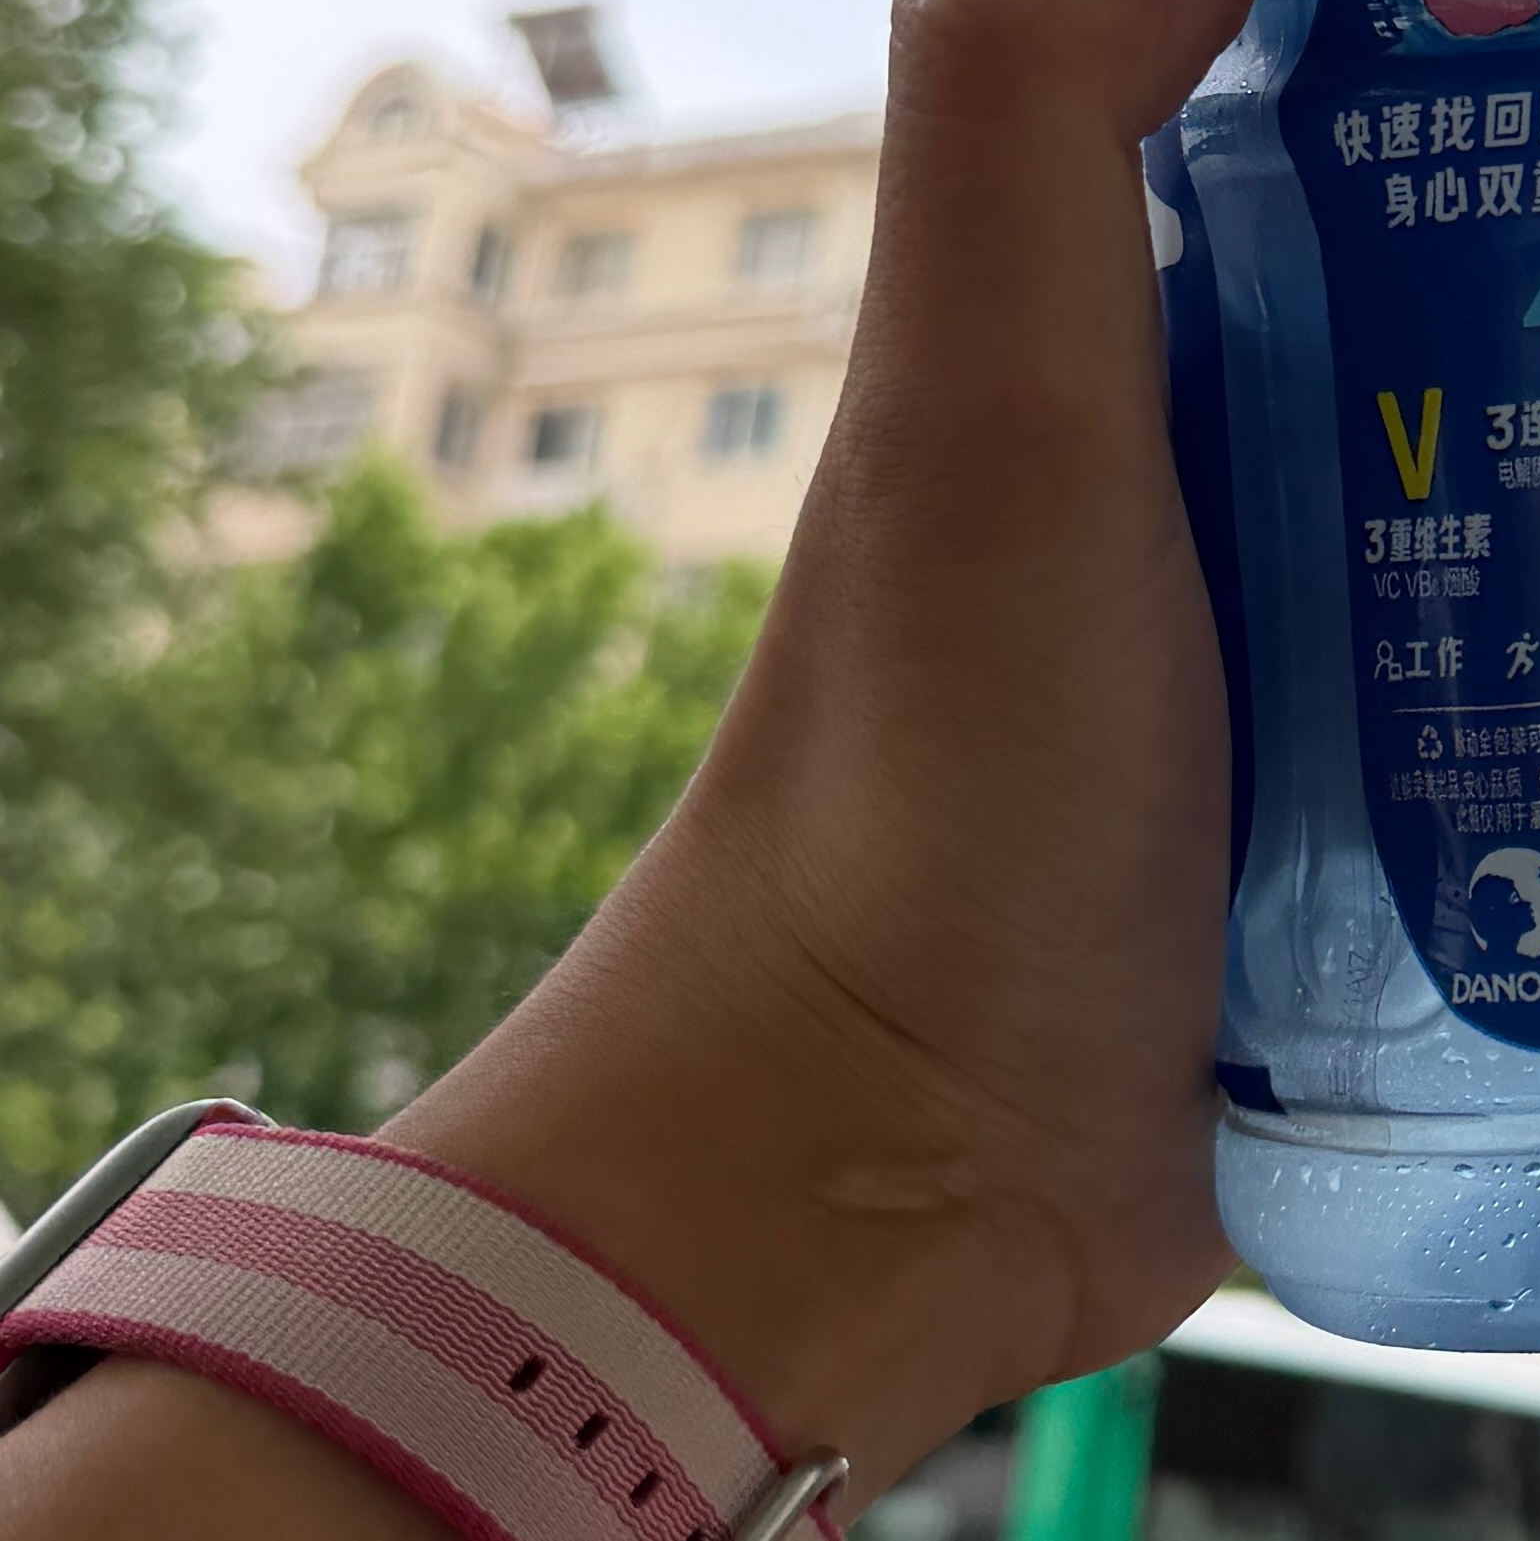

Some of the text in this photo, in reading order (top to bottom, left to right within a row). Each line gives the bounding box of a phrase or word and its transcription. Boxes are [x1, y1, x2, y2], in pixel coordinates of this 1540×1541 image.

[1377, 387, 1442, 501] V
[1364, 513, 1493, 564] 3重维生素
[1404, 637, 1464, 678] 工作
